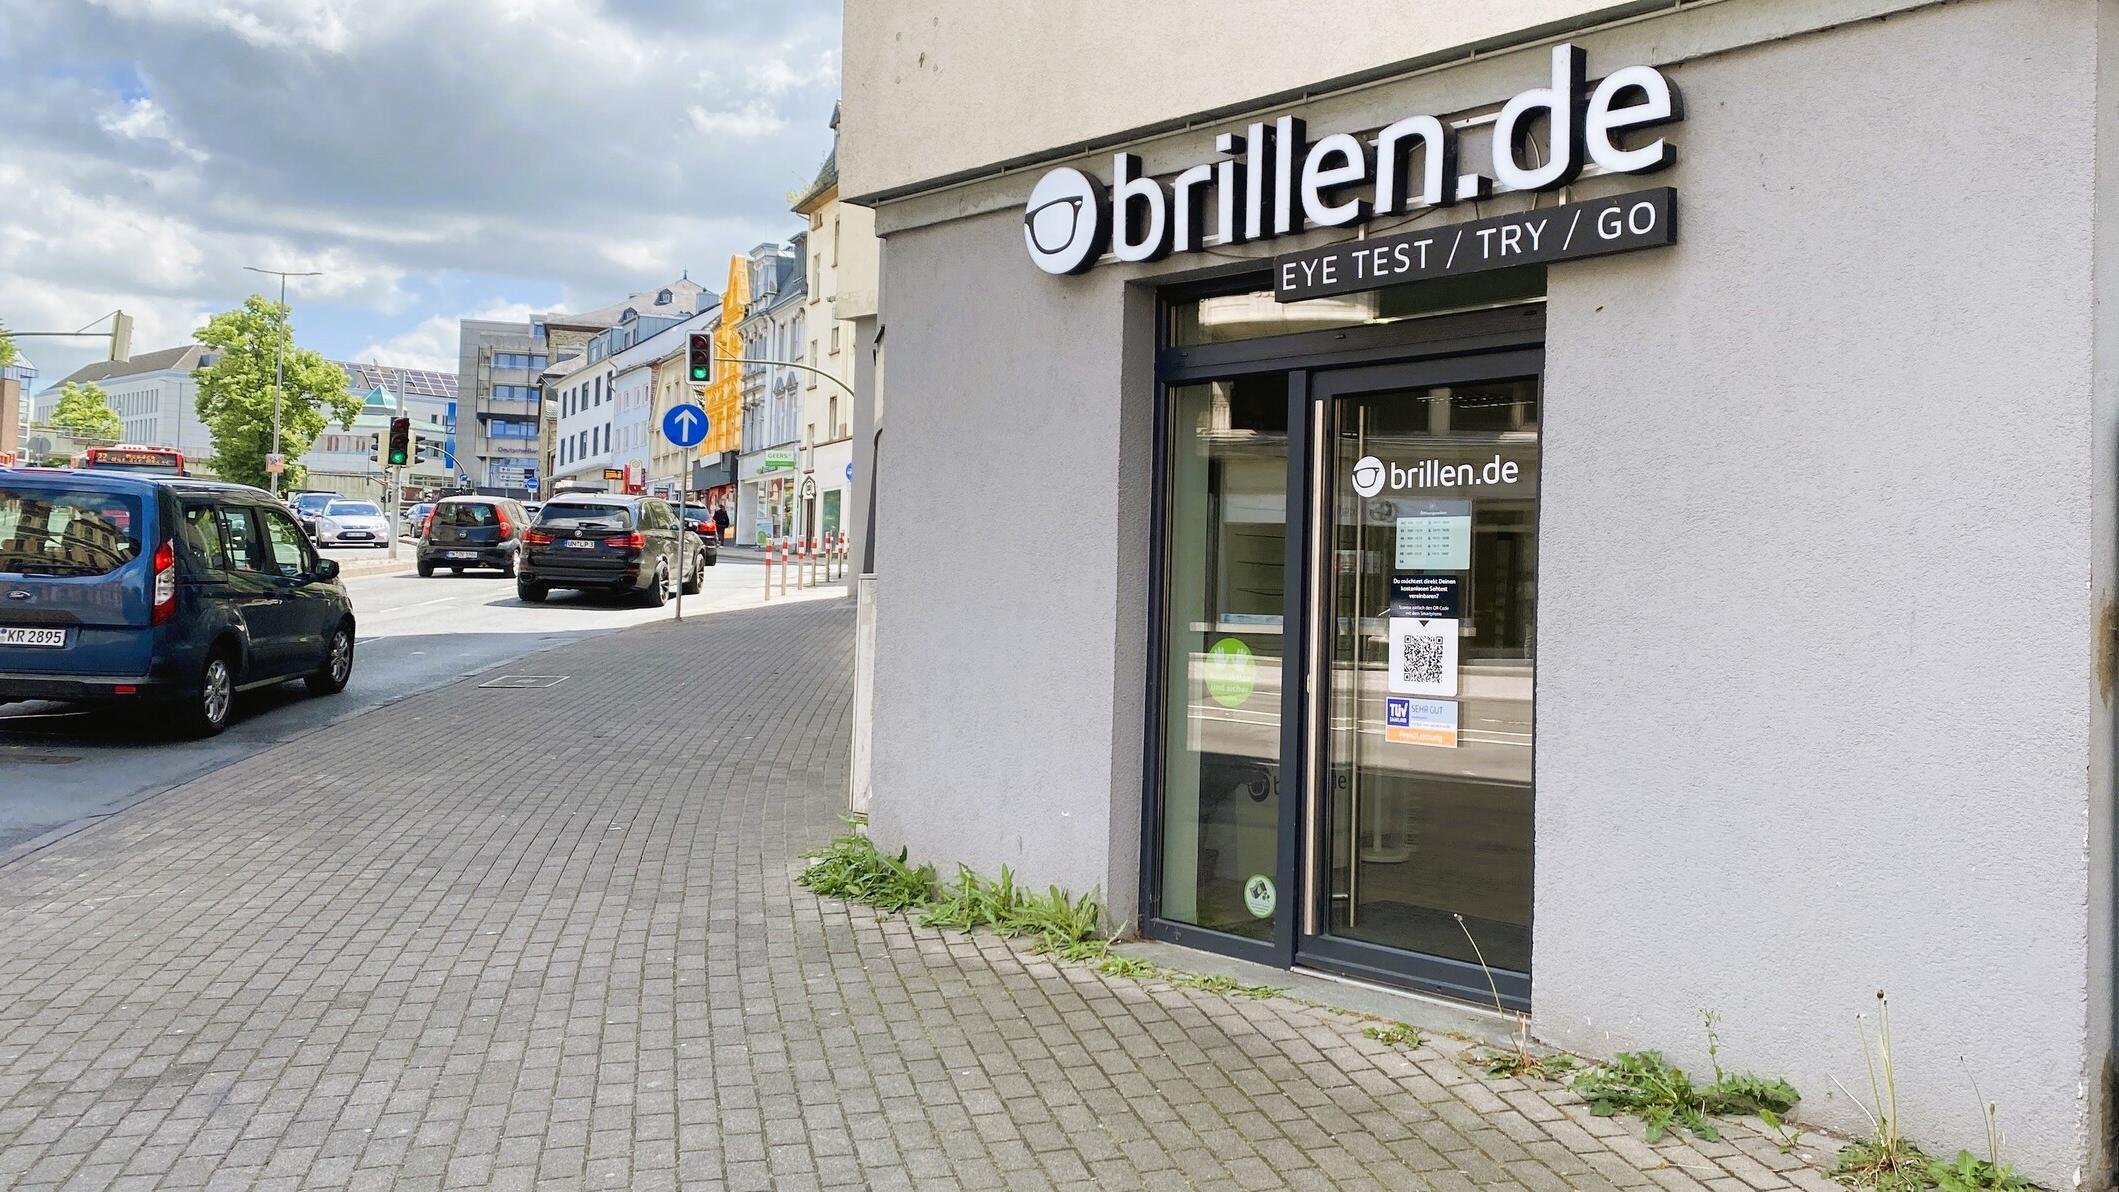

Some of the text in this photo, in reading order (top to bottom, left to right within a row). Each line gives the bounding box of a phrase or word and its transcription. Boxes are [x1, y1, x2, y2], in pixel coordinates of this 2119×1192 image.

[1113, 43, 1684, 261] brillen.de
[1282, 201, 1656, 291] EYE TEST / TRY / GO
[1390, 454, 1519, 490] brillen.de
[7, 630, 62, 644] KR 2895
[1389, 703, 1408, 718] TÜV
[1411, 705, 1443, 714] SEHR GUT
